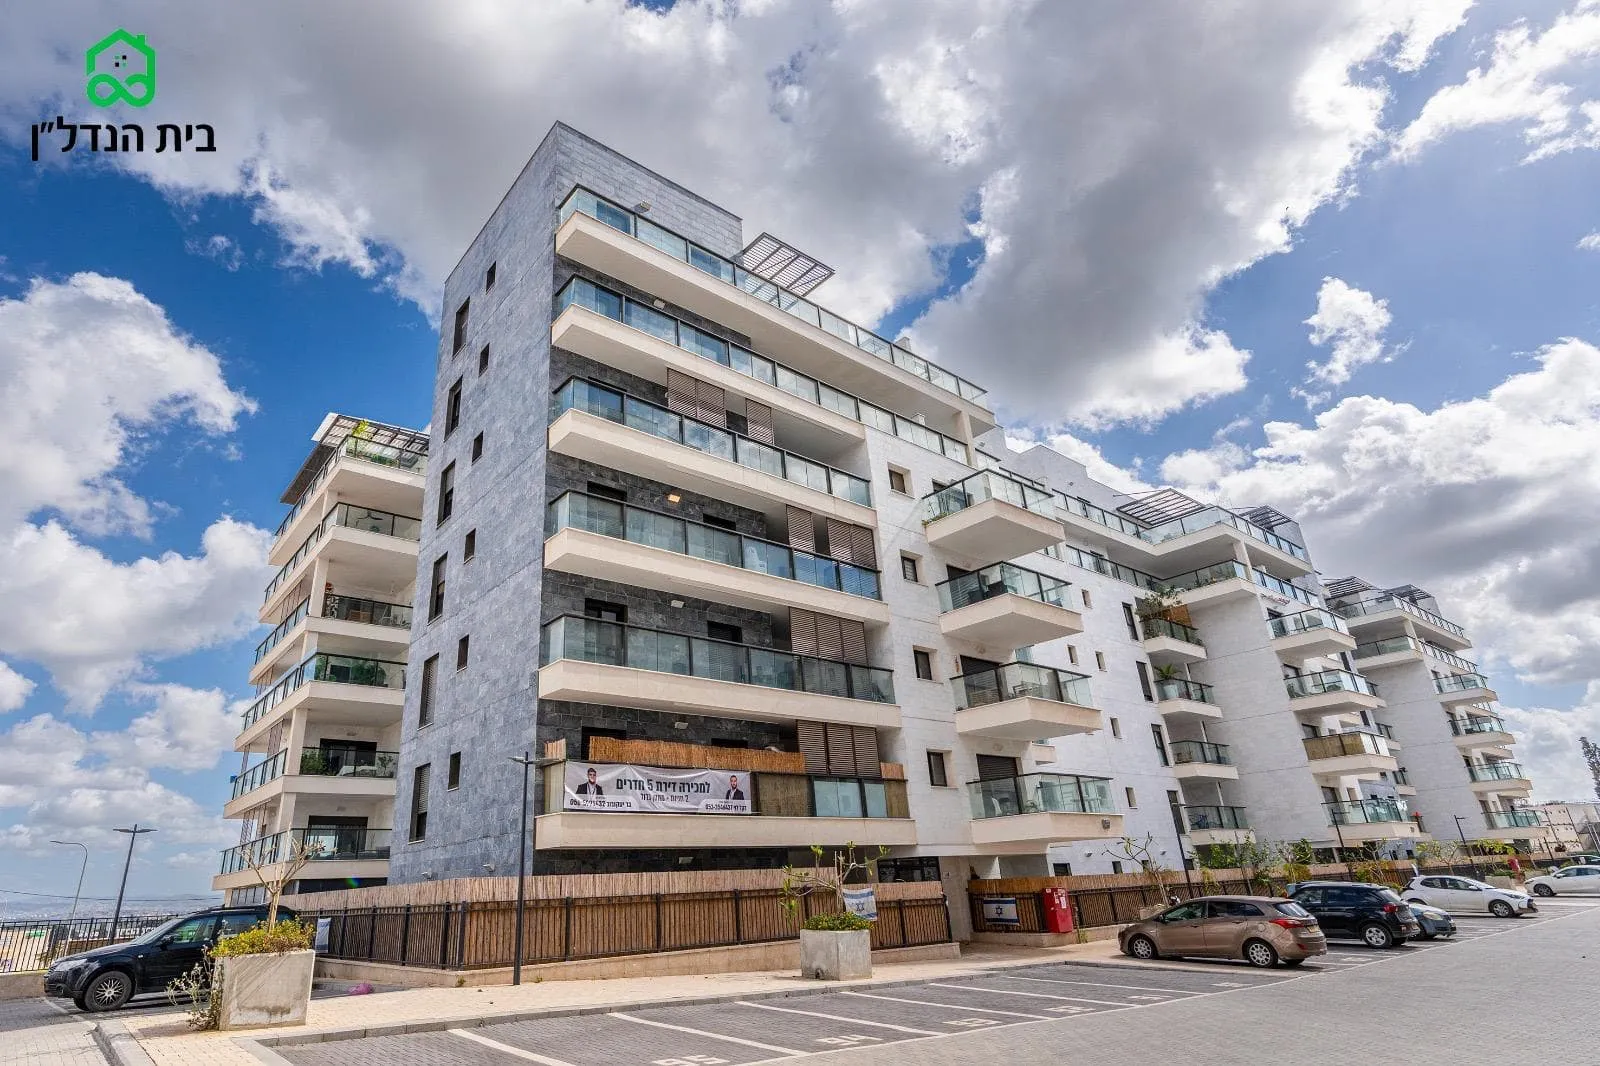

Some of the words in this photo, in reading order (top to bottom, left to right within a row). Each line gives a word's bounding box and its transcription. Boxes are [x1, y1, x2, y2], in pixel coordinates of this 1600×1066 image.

[616, 778, 645, 791] חדרים
[647, 779, 654, 791] 5
[655, 780, 677, 792] דירת
[679, 781, 711, 794] למכירה
[815, 1034, 885, 1046] 94
